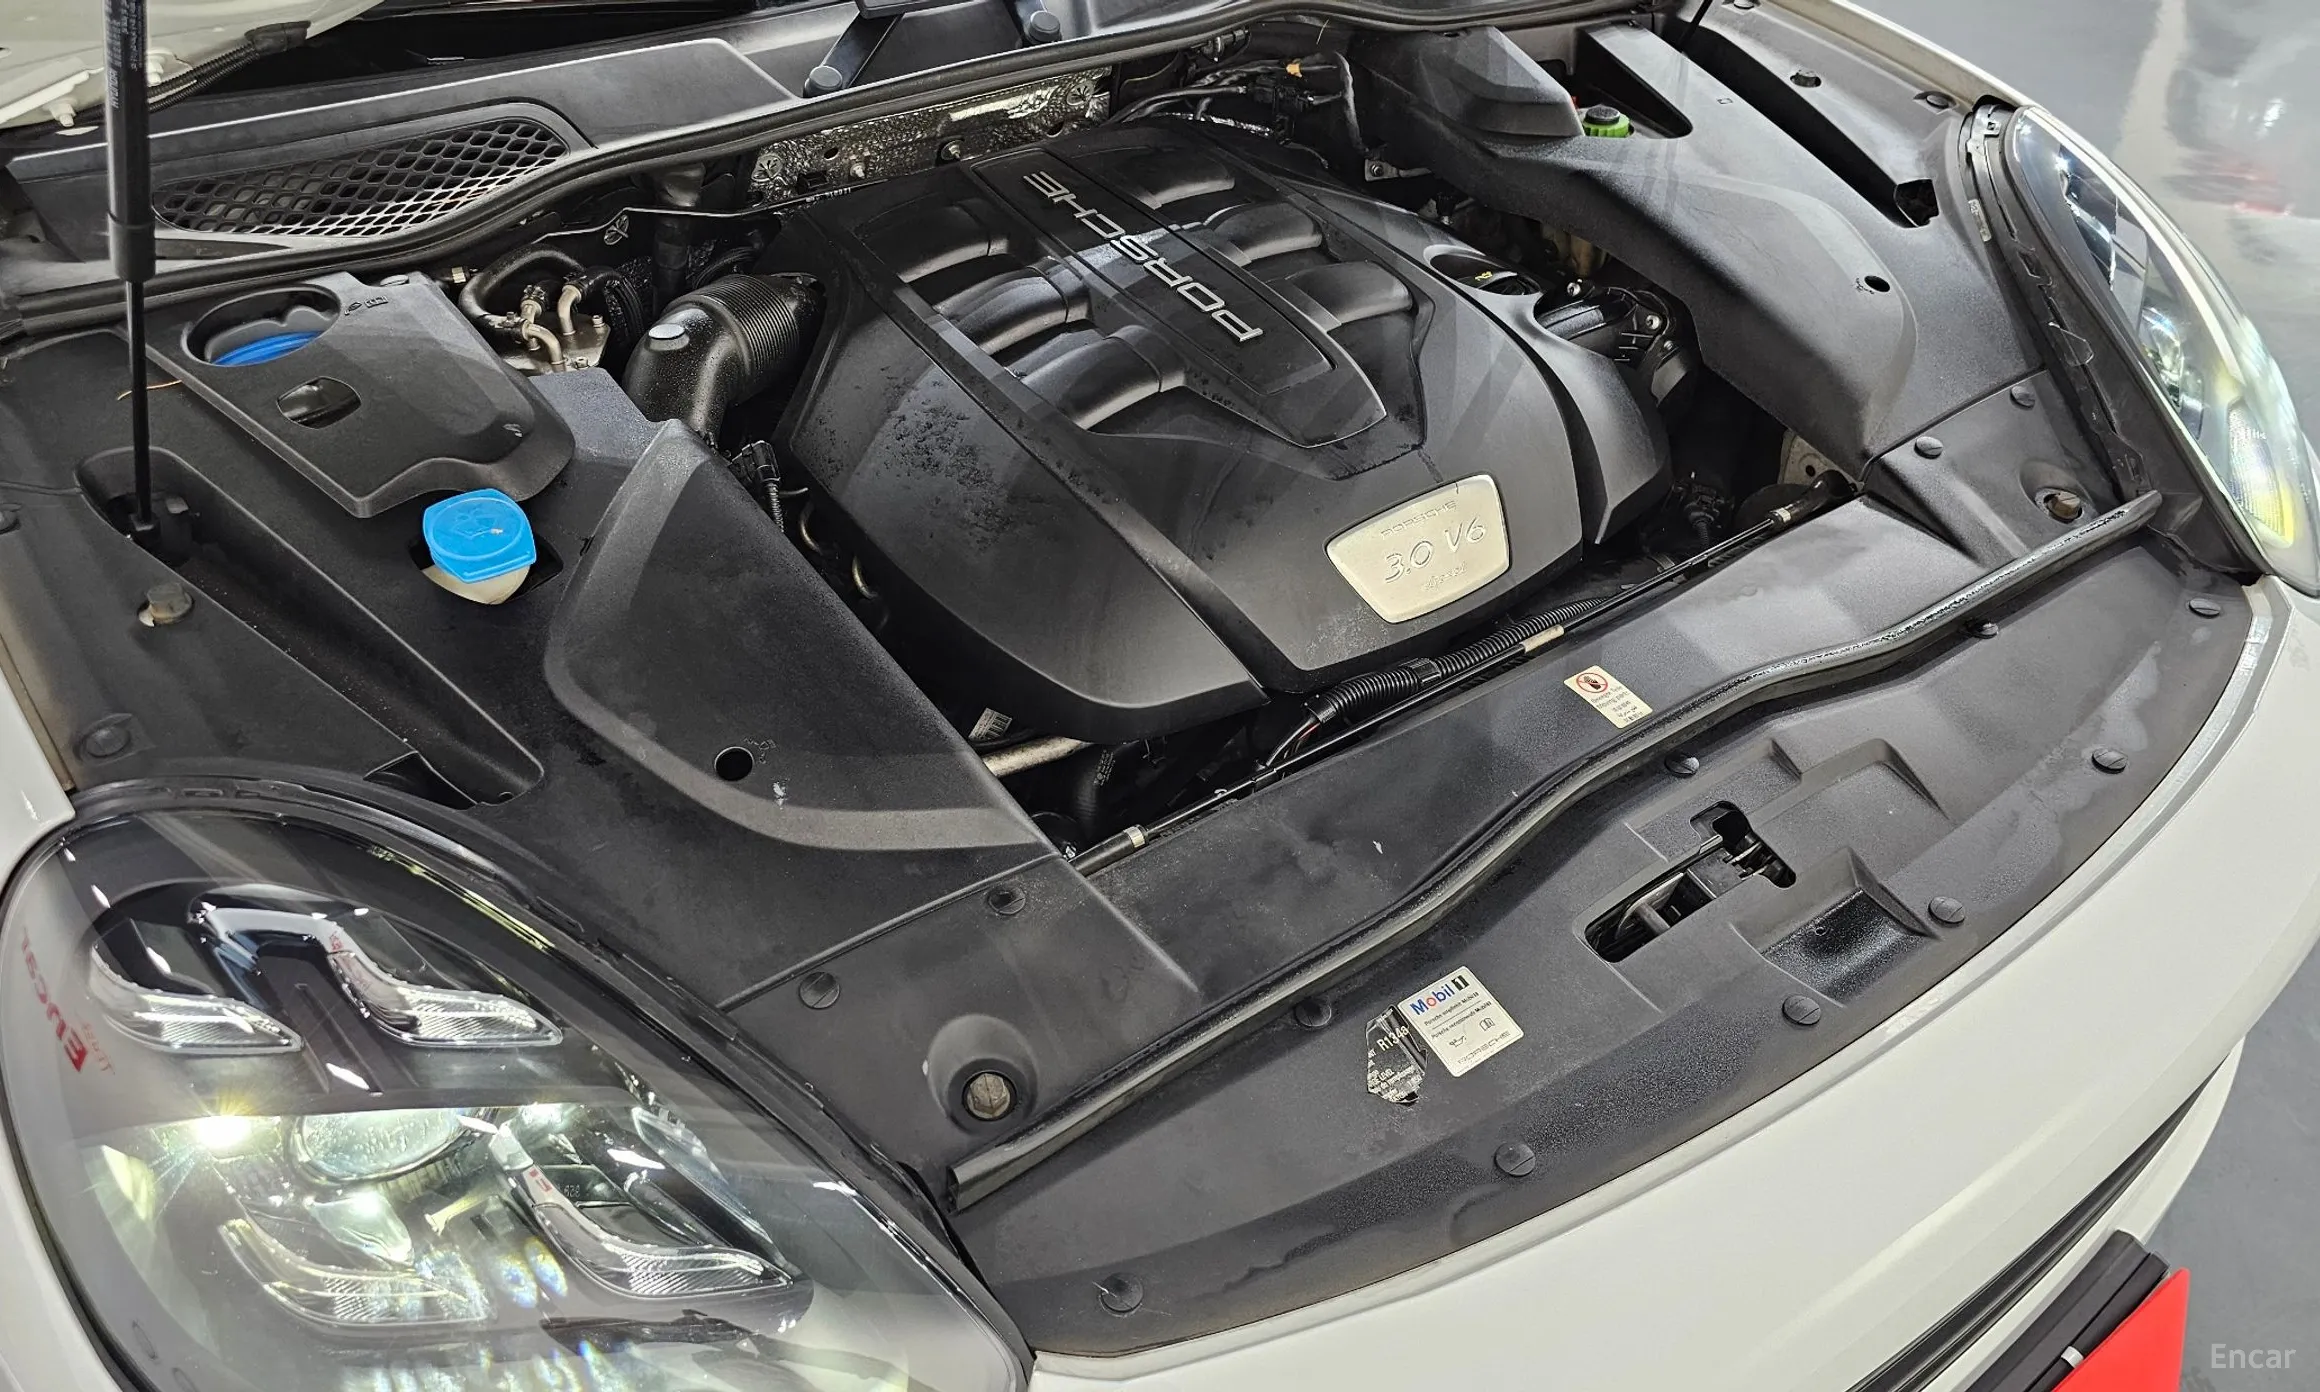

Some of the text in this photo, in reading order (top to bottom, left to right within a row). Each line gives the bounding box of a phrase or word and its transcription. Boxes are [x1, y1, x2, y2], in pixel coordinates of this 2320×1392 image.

[1023, 171, 1264, 342] PORSCHE
[1380, 500, 1458, 540] PORSCHE
[1385, 516, 1487, 583] 3.0 V6
[1409, 983, 1455, 1015] Mobil
[1376, 1025, 1410, 1051] R134a
